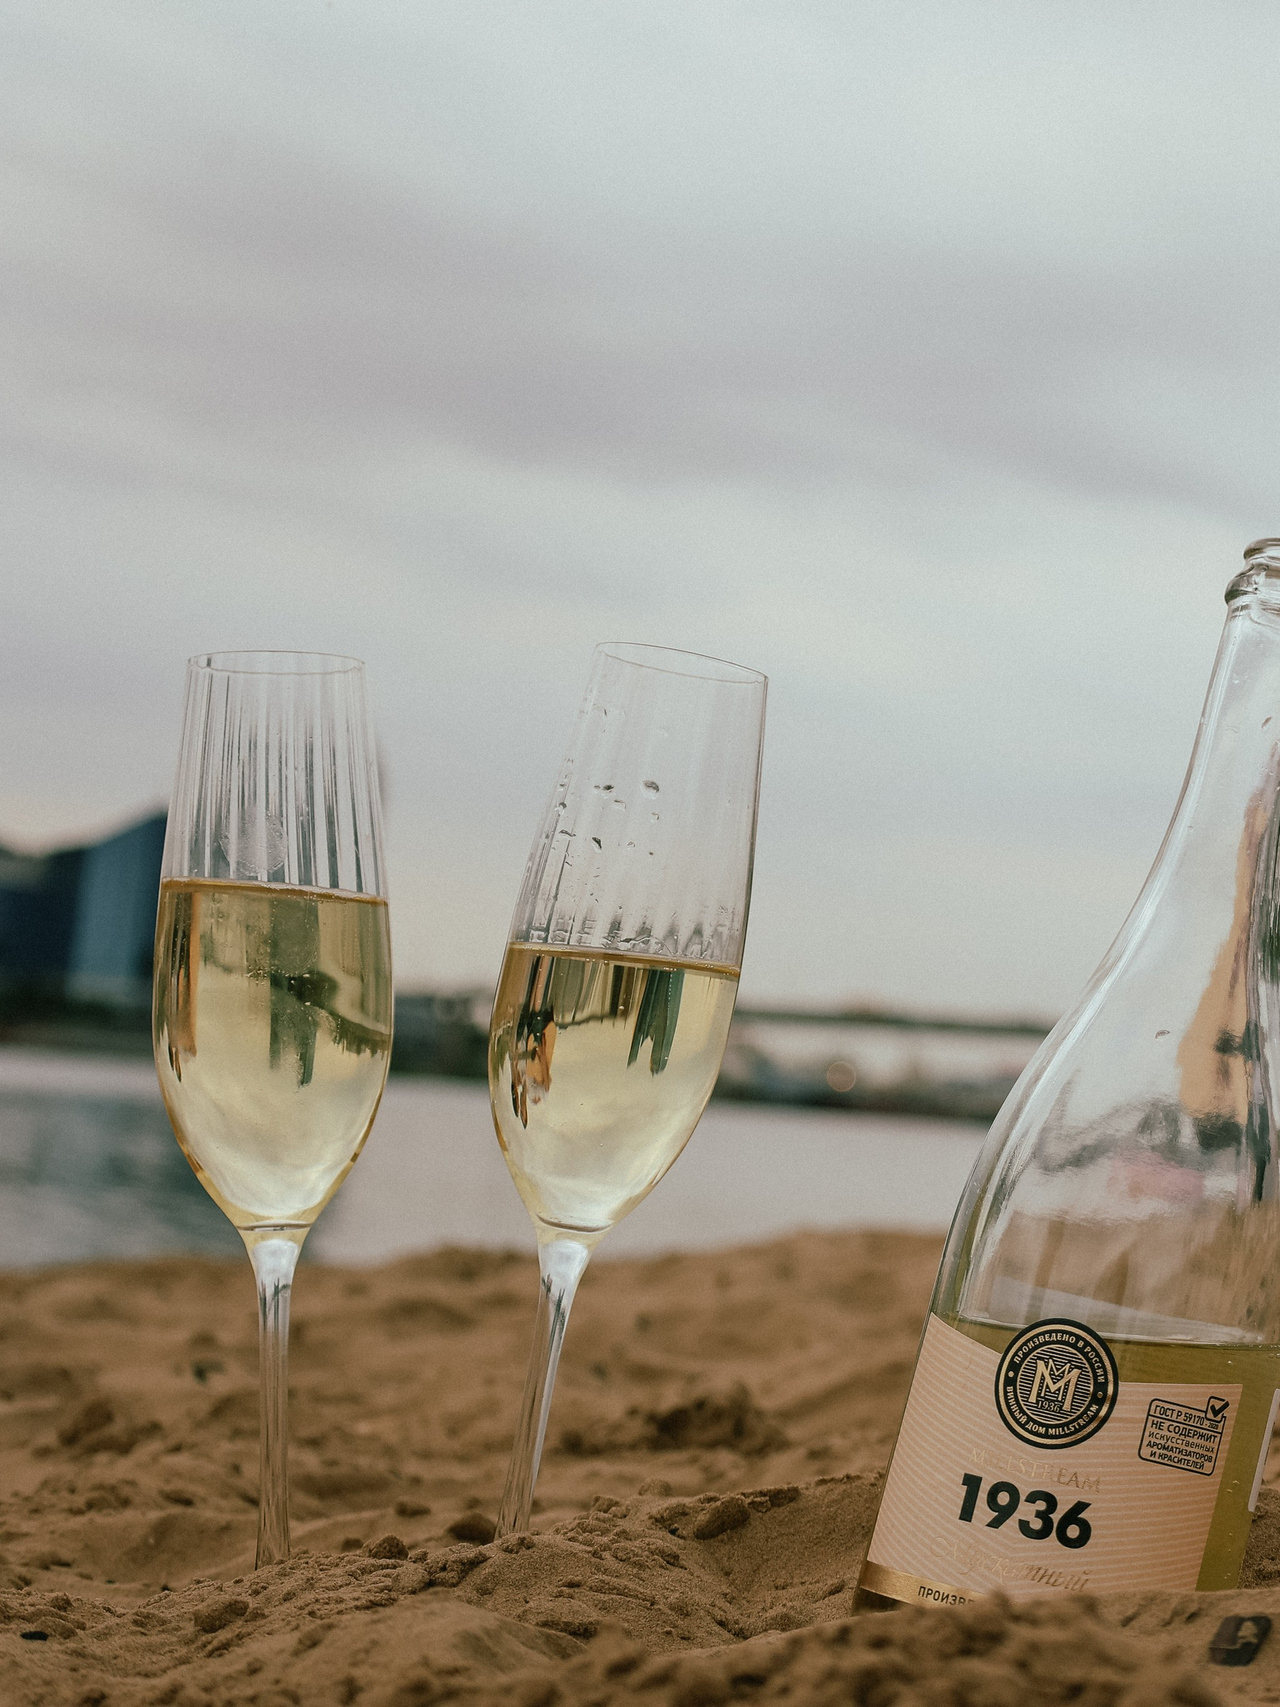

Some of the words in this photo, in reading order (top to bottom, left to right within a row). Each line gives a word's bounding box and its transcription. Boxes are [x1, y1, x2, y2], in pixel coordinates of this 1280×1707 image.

[1013, 1332, 1076, 1364] ПРОИЗВЕДЕНО
[1077, 1340, 1084, 1348] В
[1083, 1345, 1105, 1383] РОССИИ
[1006, 1385, 1028, 1425] ВИННЫЙ
[1025, 1421, 1046, 1434] ДОМ
[1047, 1404, 1099, 1435] MILLSTREAM
[1037, 1400, 1061, 1413] 1936
[1153, 1404, 1176, 1418] ГОСТ
[1148, 1430, 1215, 1454] искусственных
[1150, 1419, 1165, 1431] НЕ
[1167, 1423, 1218, 1444] СОДЕРЖИТ
[1146, 1440, 1213, 1463] АРОМАТИЗАТОРОВ
[1149, 1450, 1156, 1458] И
[1158, 1451, 1205, 1470] КРАСИТЕЛЕЙ
[958, 1472, 1092, 1549] 1936
